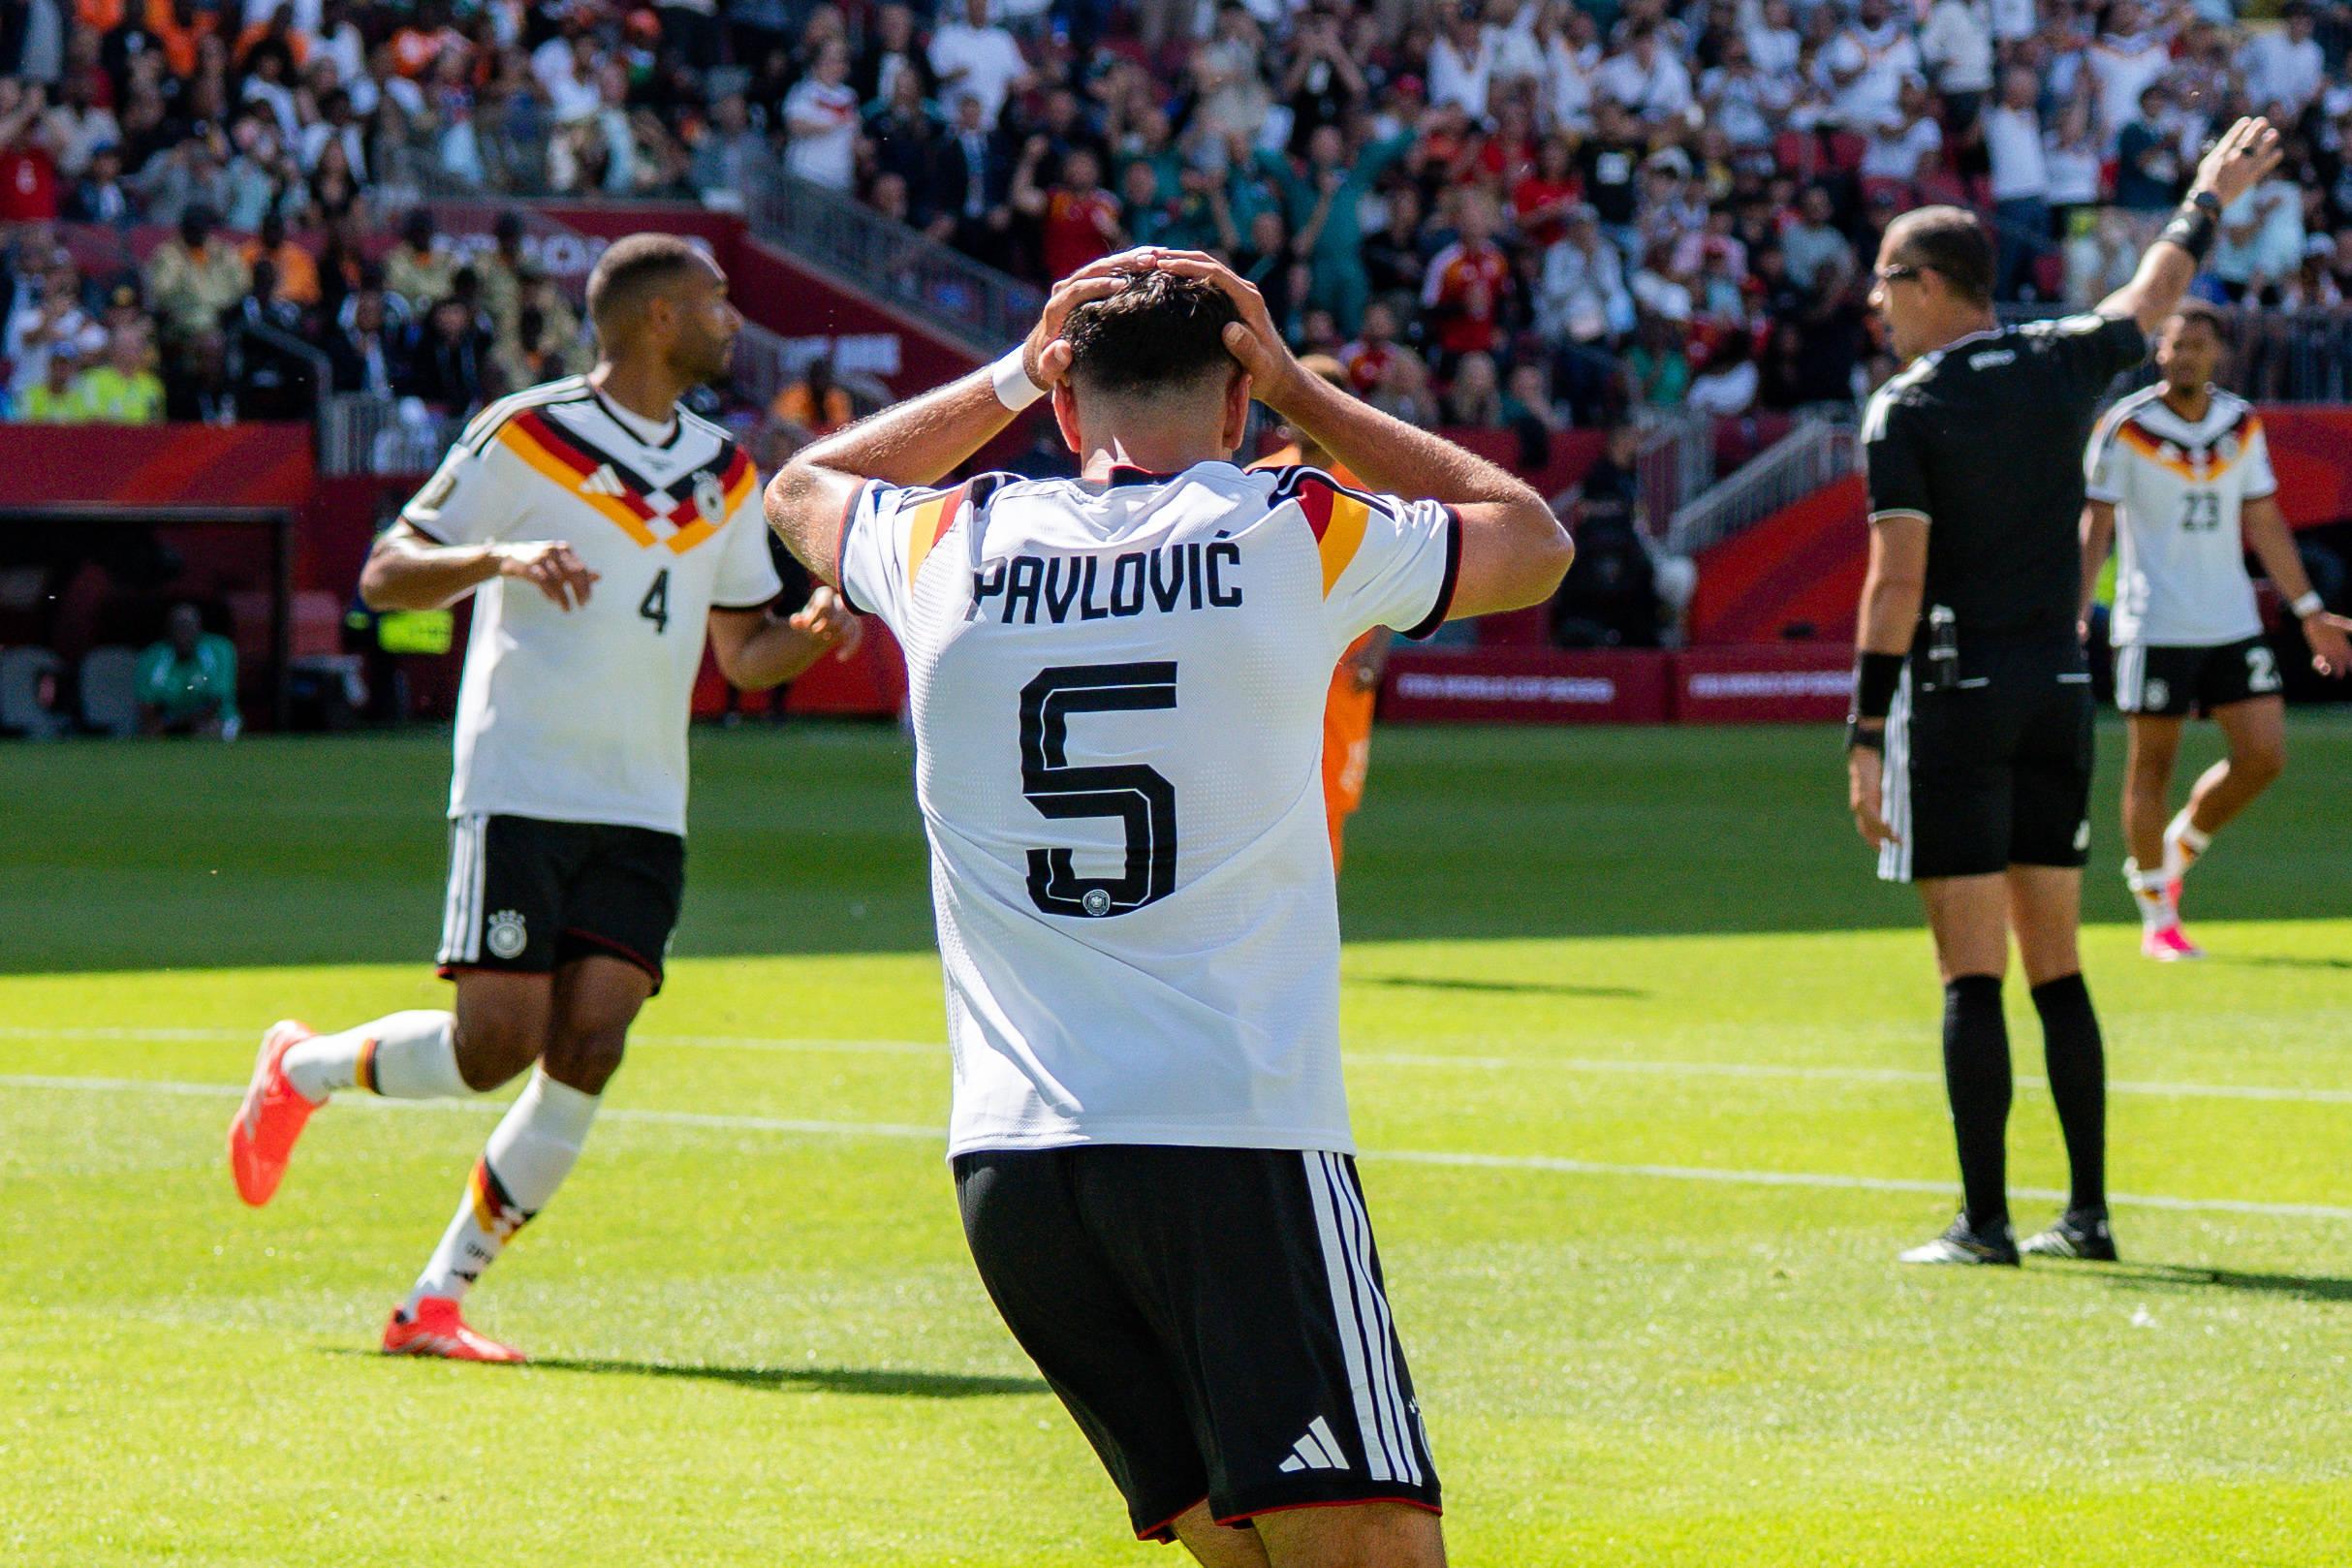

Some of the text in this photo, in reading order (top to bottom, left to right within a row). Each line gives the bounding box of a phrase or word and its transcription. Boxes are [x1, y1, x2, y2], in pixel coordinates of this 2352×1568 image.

[2181, 490, 2219, 532] 23
[639, 566, 670, 635] 4
[964, 529, 1243, 624] PAVLOVIĆ
[2244, 645, 2282, 692] 2
[1019, 660, 1178, 919] 5
